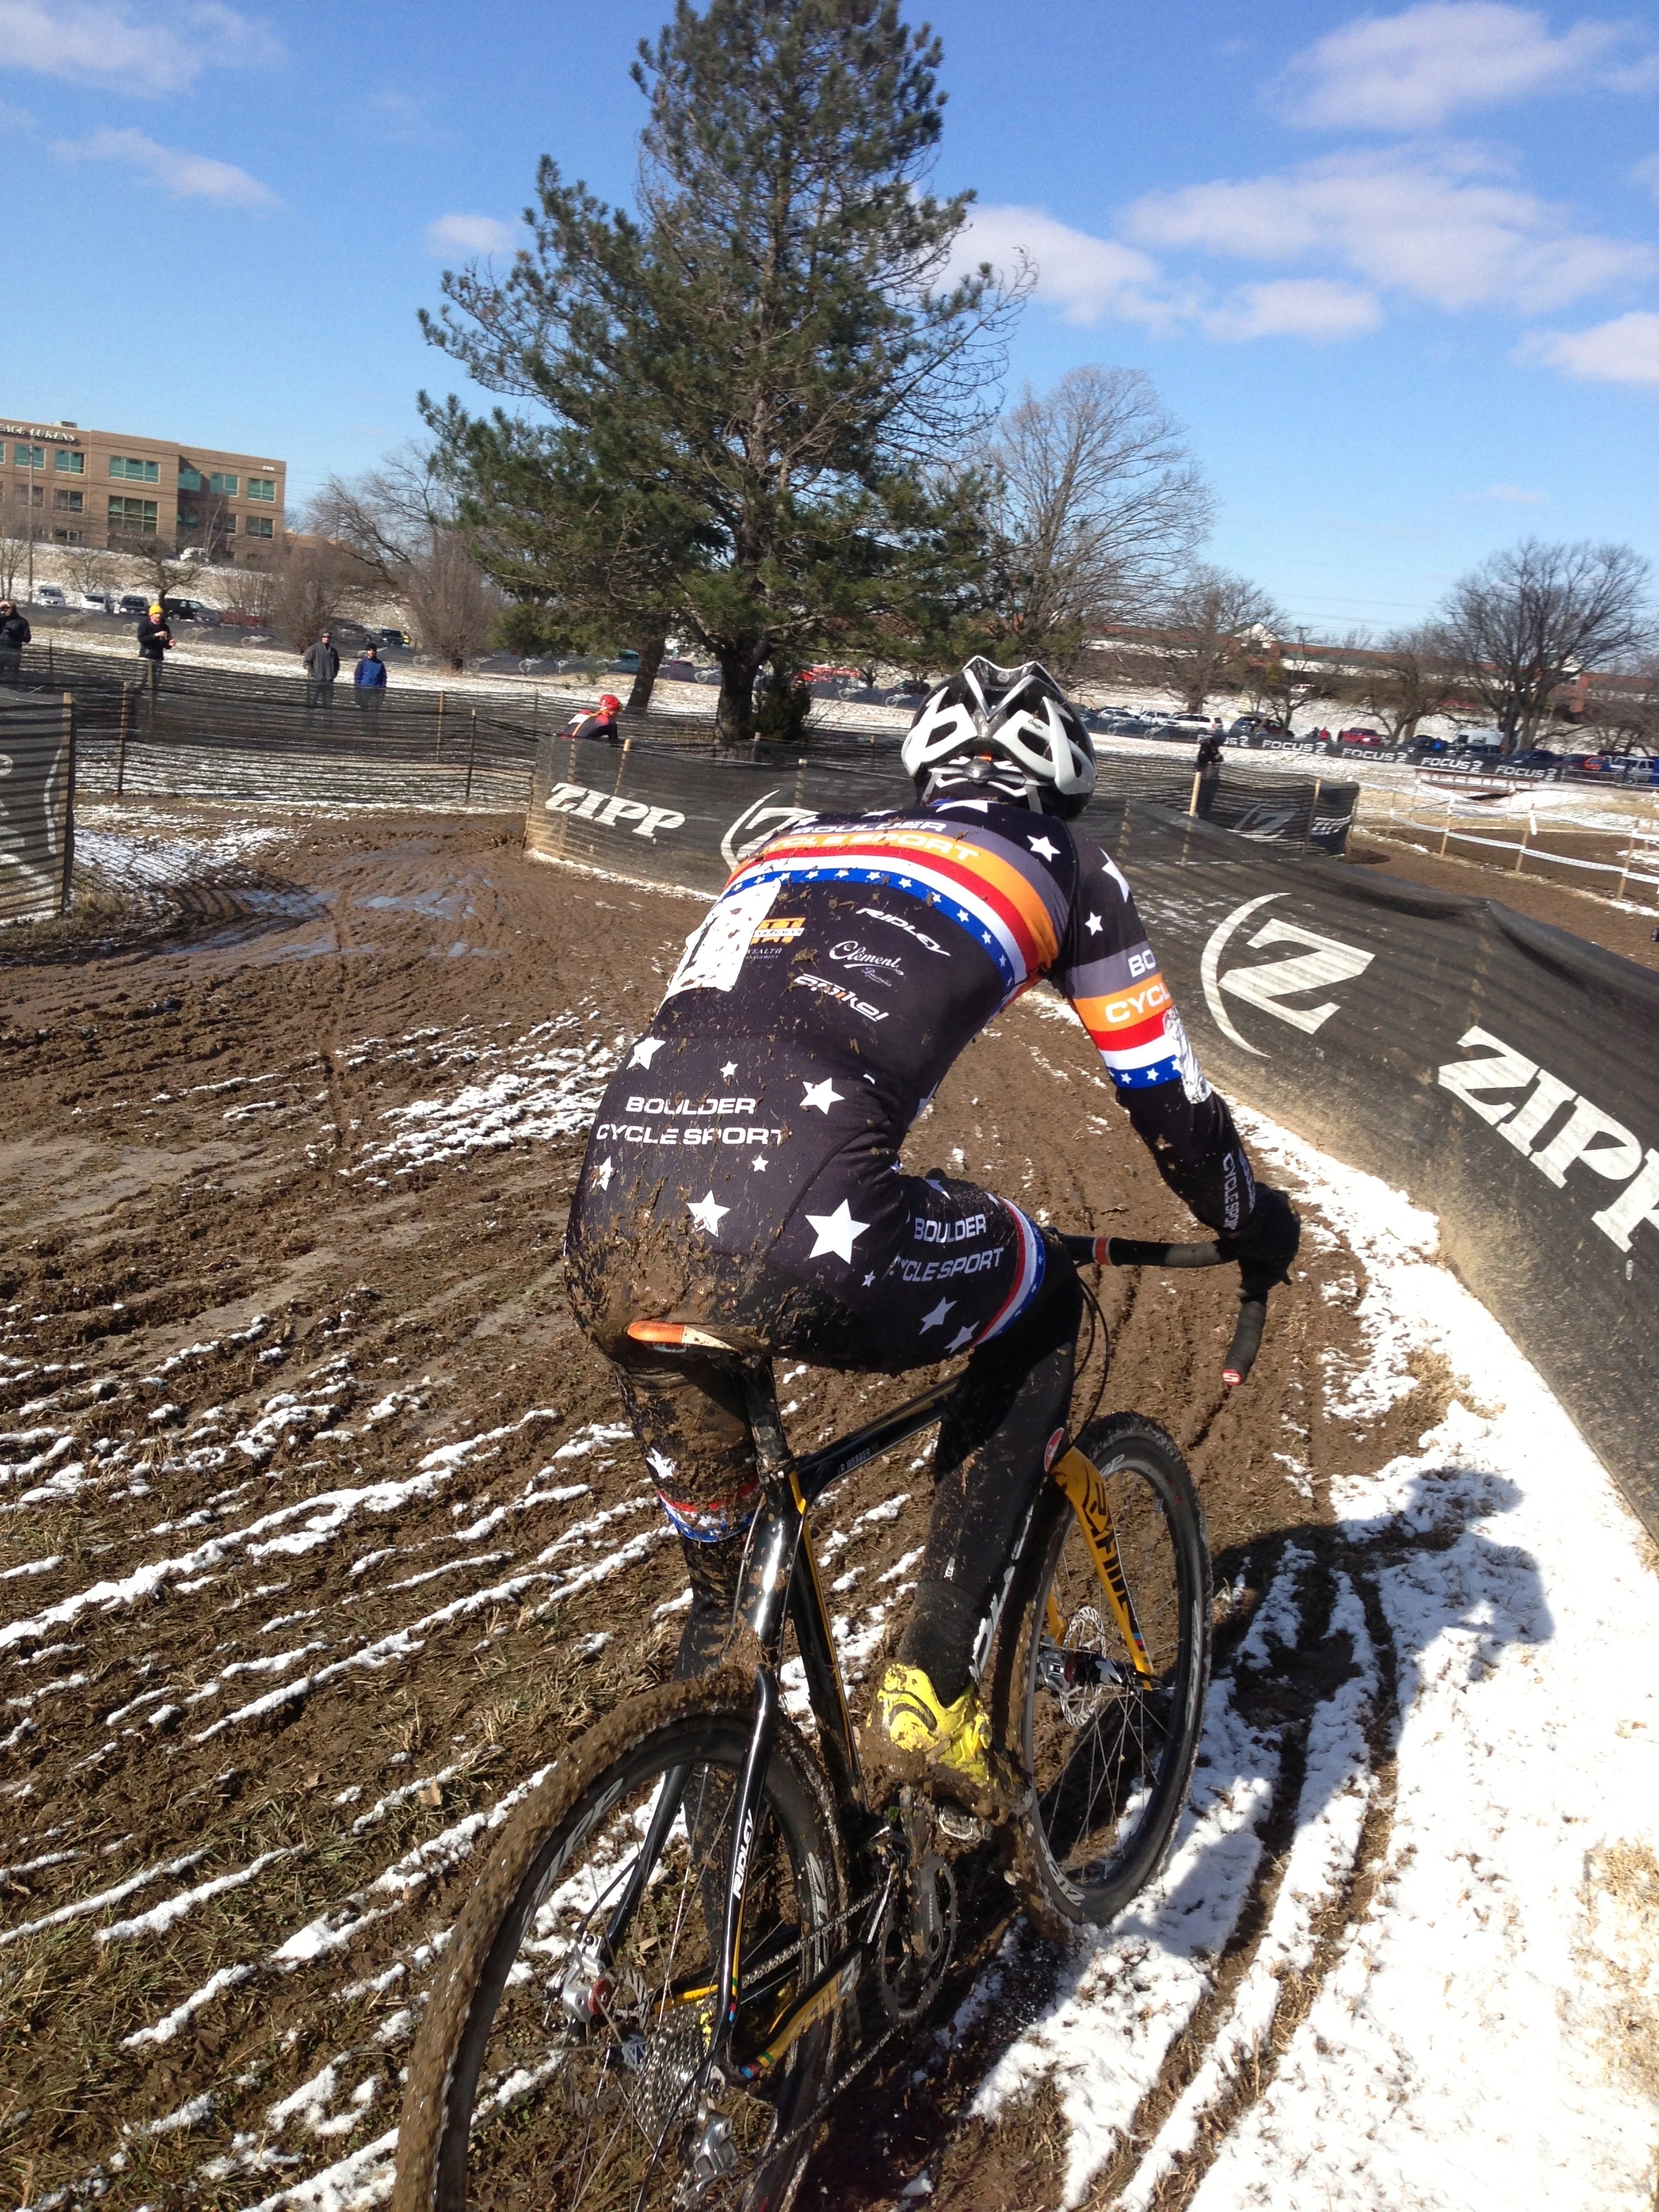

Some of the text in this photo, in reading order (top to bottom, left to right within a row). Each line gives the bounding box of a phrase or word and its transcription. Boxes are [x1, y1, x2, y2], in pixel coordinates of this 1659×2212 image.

[1262, 739, 1313, 752] FOCUS
[1341, 747, 1395, 762] FOCUS
[1421, 756, 1471, 770] FOCUS
[1495, 764, 1547, 779] FOCUS
[544, 782, 686, 838] ZIPP
[790, 821, 947, 835] BOULDER
[849, 833, 980, 861] SPORT
[855, 907, 951, 956] RIDLEY
[626, 1096, 756, 1115] BOULDER
[596, 1124, 792, 1146] CYCLE SPORT
[1437, 1025, 1659, 1253] ZIPP
[914, 1213, 987, 1244] BOULDER
[937, 1247, 1004, 1279] SPORT
[732, 1808, 754, 1900] RIDLEY
